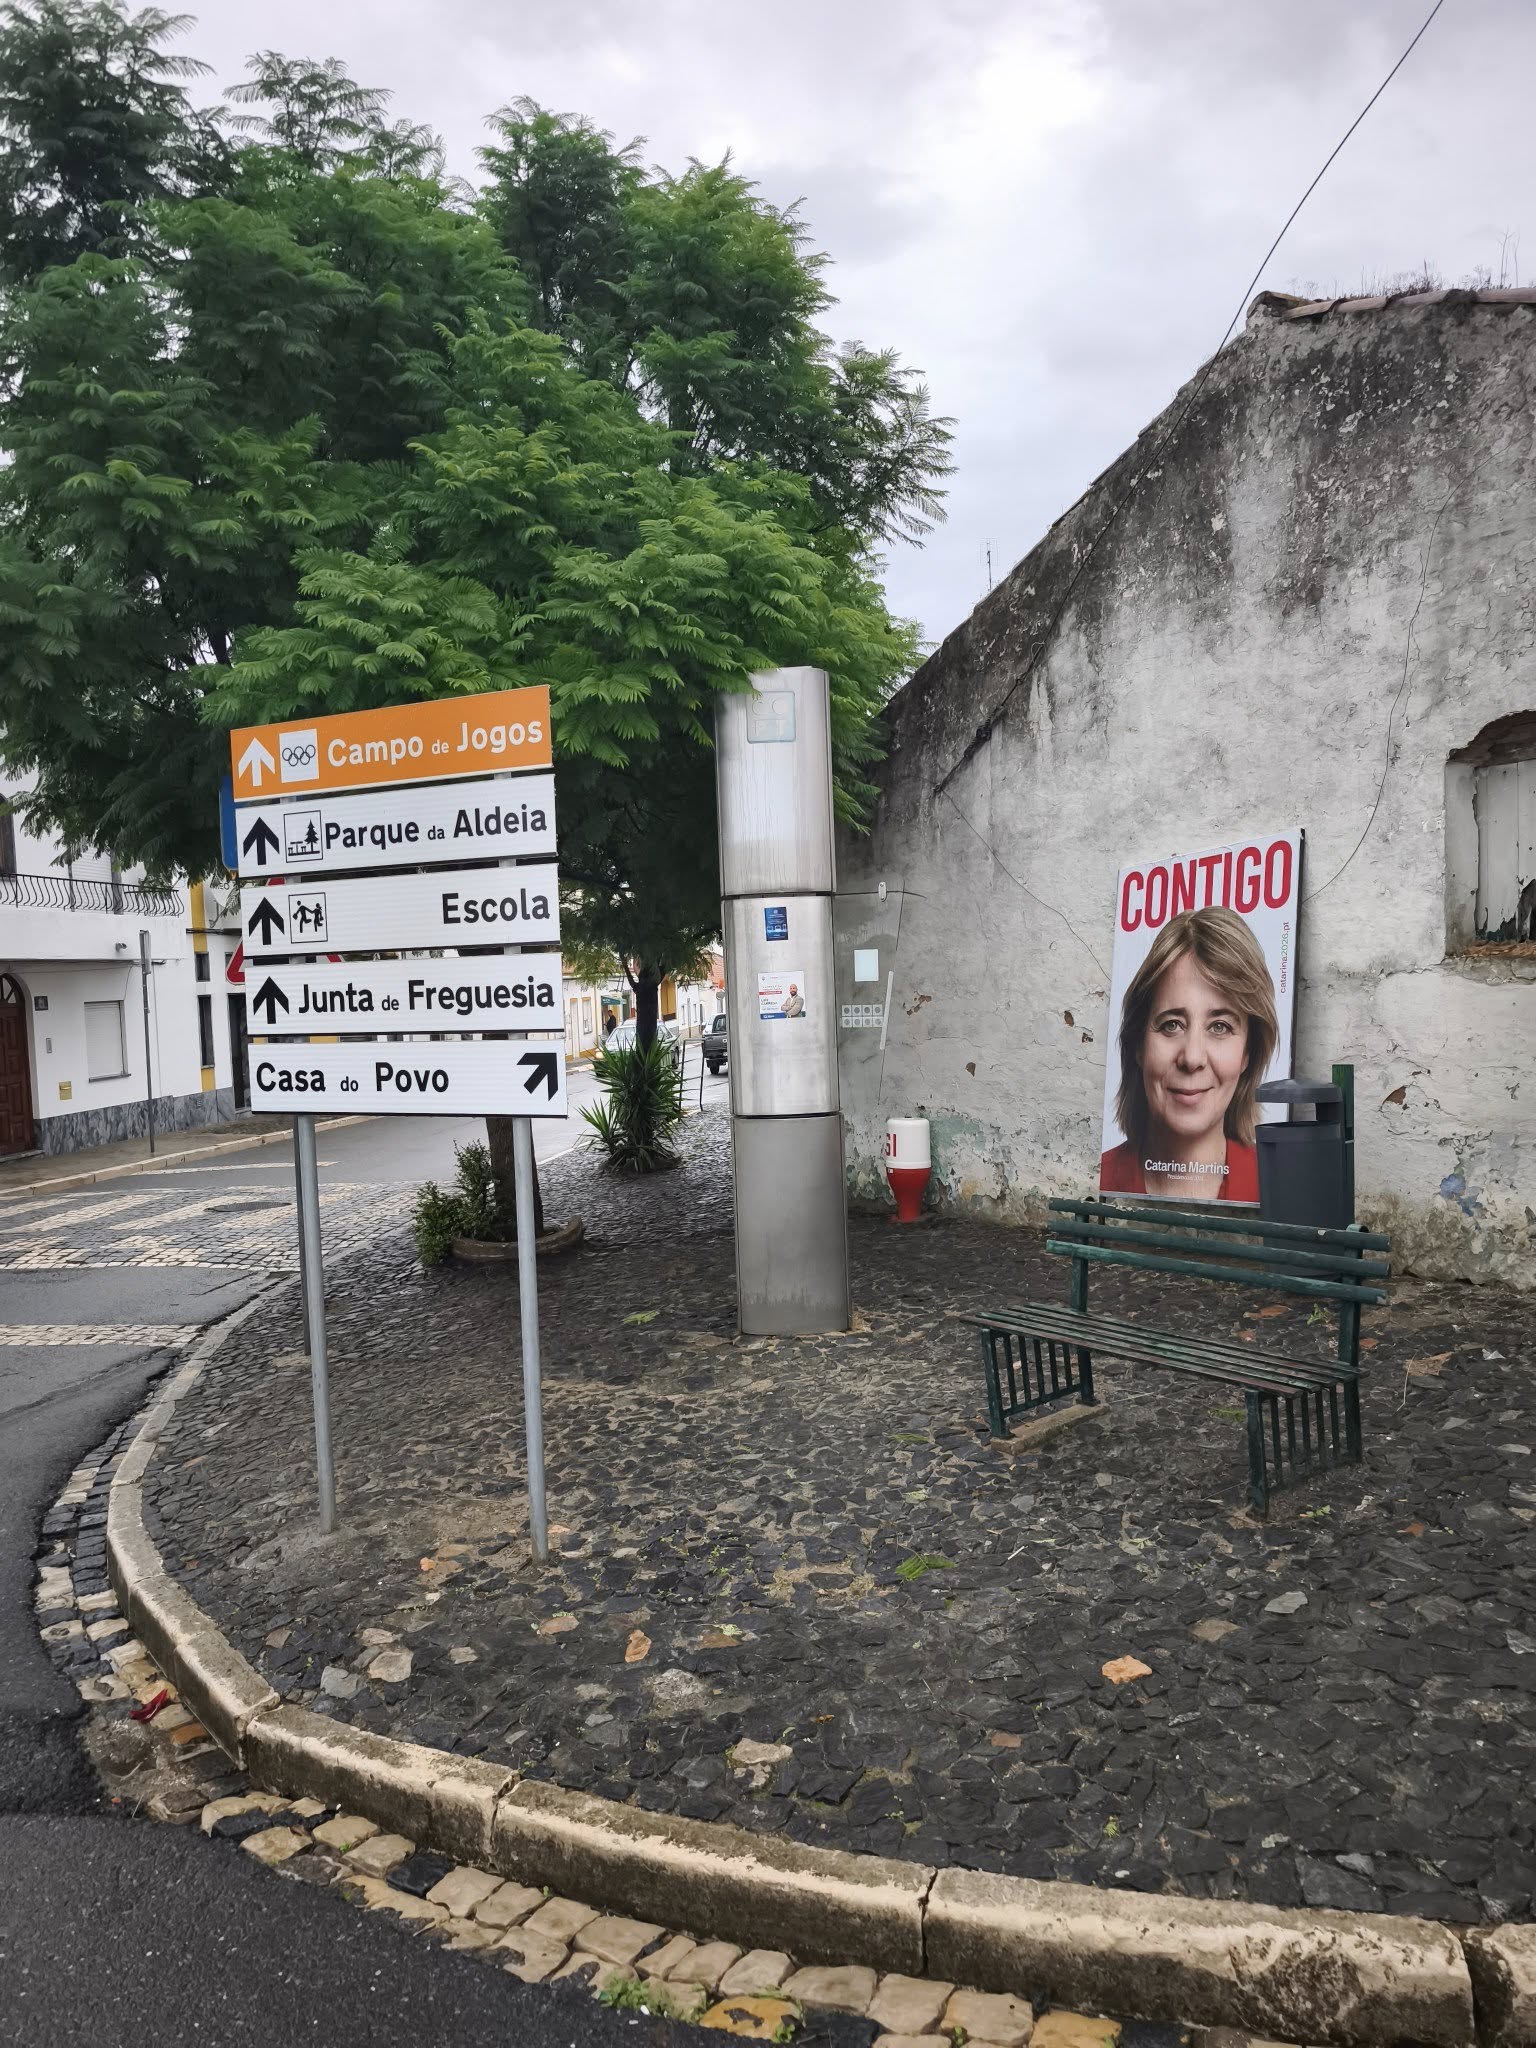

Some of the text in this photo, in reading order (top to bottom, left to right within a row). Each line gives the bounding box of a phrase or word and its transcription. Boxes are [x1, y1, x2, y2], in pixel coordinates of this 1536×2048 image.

[327, 720, 544, 767] Campo de Jogos
[325, 804, 547, 850] Parque da Aldeia
[442, 888, 550, 924] Escola
[1120, 840, 1292, 932] CONTIGO
[1280, 921, 1290, 994] catarina2026.pt
[298, 975, 555, 1015] Junta de Freguesia
[256, 1061, 449, 1092] Casa do Povo
[1144, 1159, 1230, 1175] Catarina Martins
